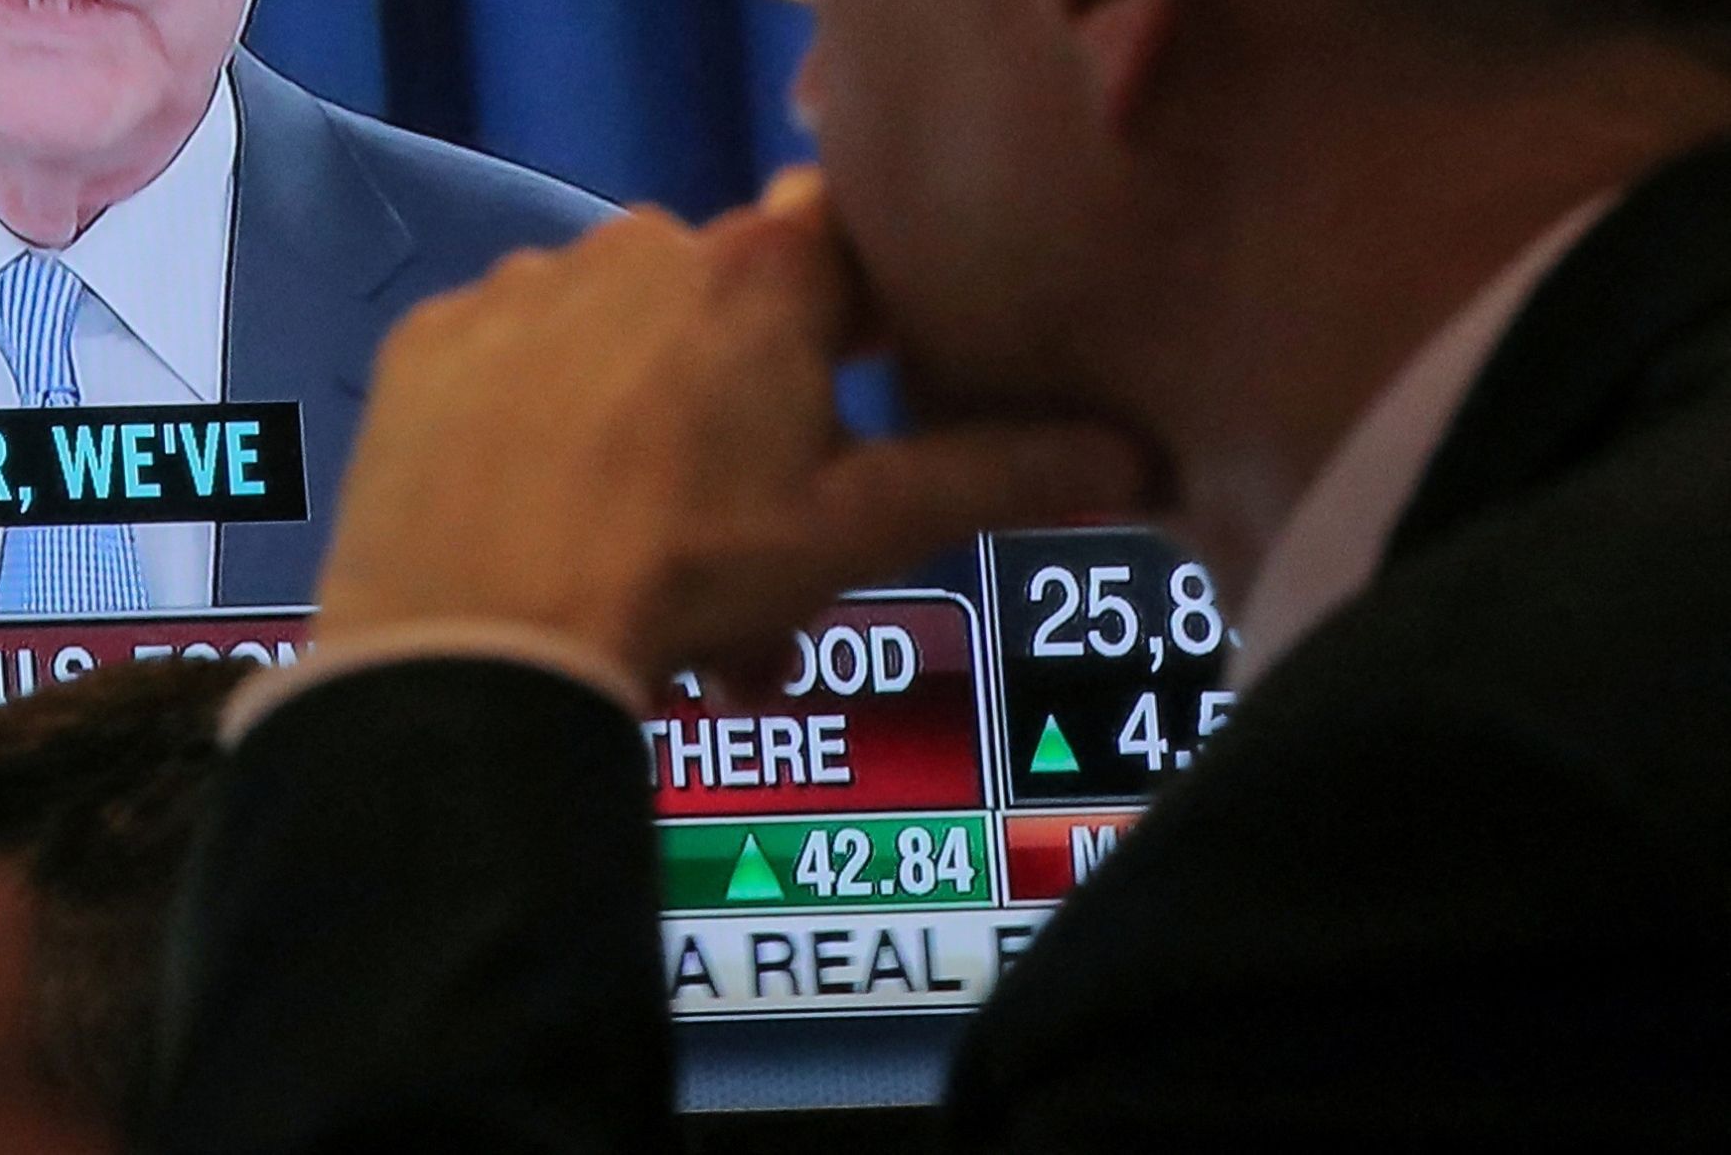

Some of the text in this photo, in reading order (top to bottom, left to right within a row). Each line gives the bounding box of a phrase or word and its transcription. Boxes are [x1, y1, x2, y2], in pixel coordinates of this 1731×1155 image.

[51, 420, 265, 501] WE'VE
[1029, 560, 1244, 673] 25,8
[639, 714, 851, 788] THERE
[794, 826, 975, 898] 42.84
[670, 934, 721, 1000] A
[750, 927, 964, 999] REAL
